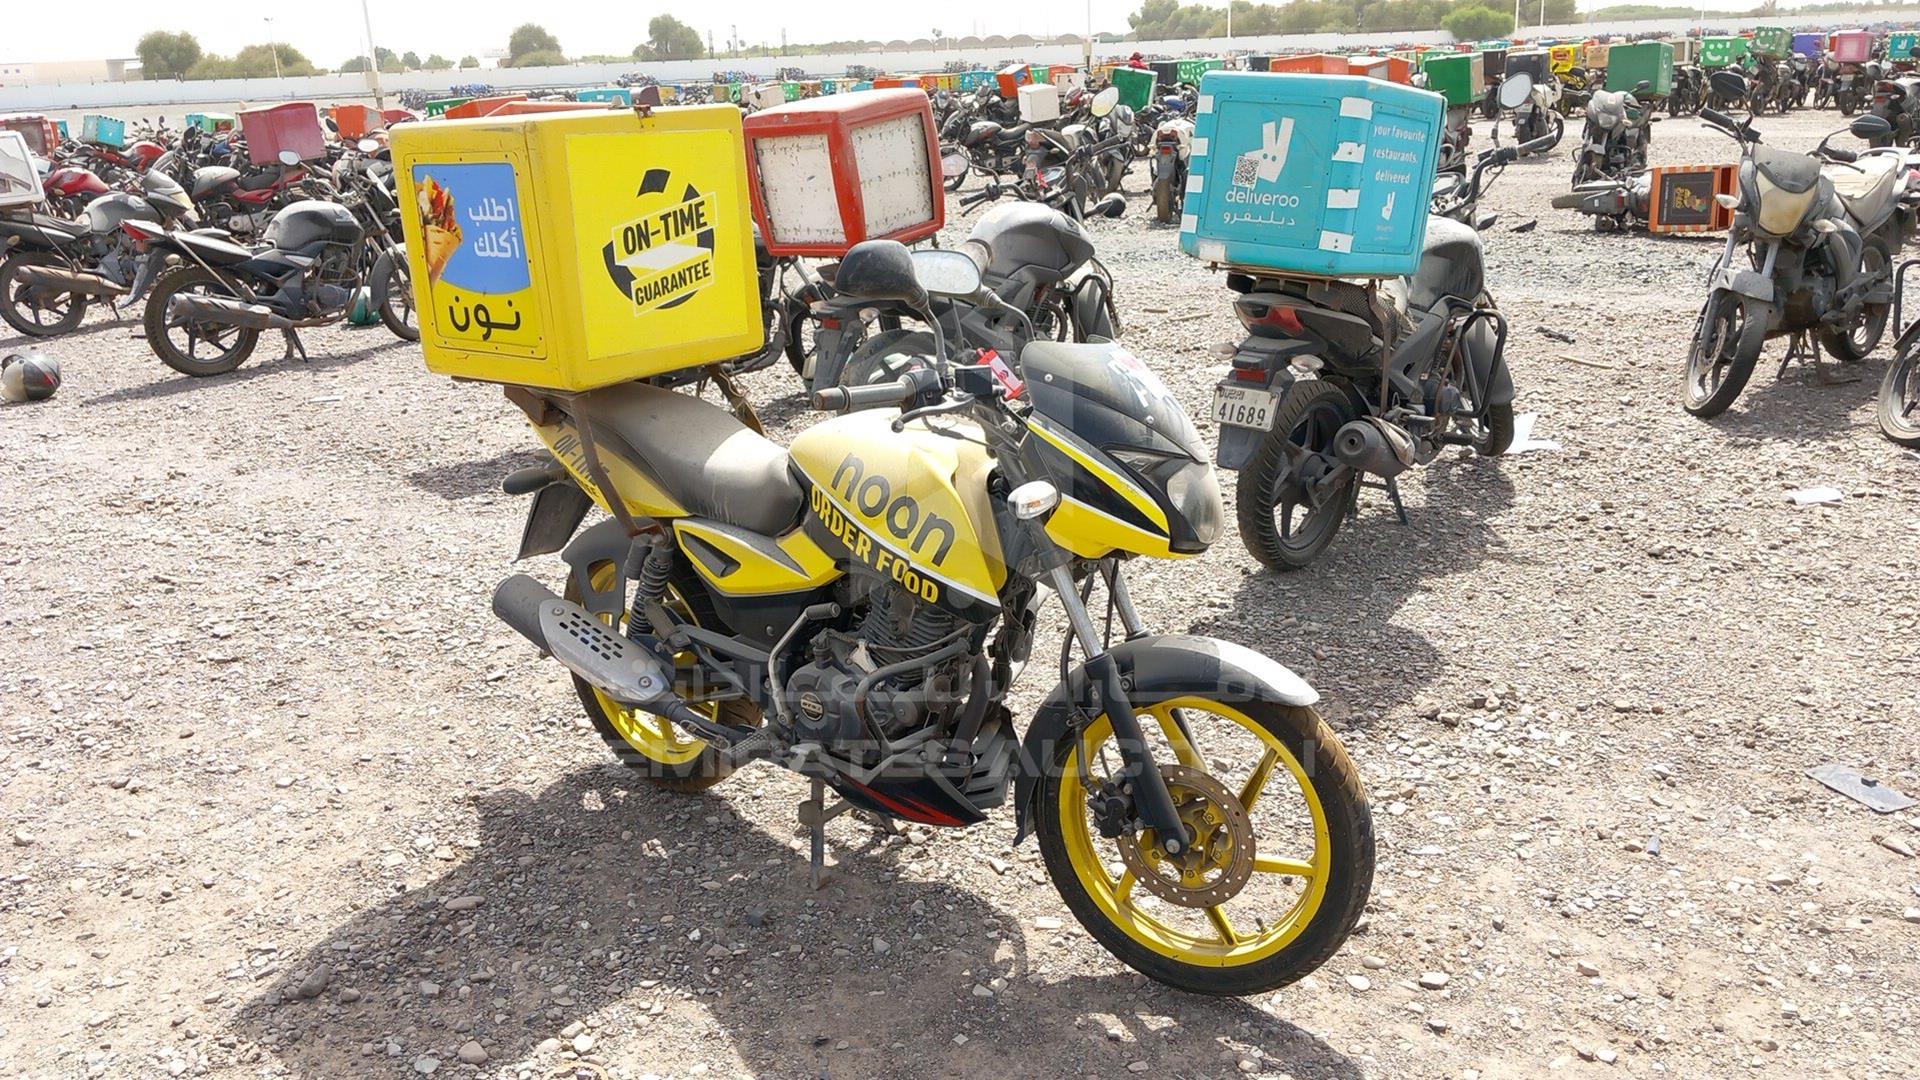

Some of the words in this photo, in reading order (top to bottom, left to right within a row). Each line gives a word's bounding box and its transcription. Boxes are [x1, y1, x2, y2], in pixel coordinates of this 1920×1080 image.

[1373, 125, 1392, 136] your
[1392, 125, 1426, 142] favourite
[1375, 169, 1411, 184] delivered
[468, 197, 515, 228] اطلب
[1225, 187, 1299, 208] deliveroo
[473, 226, 520, 259] أكلك
[622, 200, 708, 255] ON-TIME
[635, 259, 711, 306] GUARANTEE
[448, 295, 521, 341] نون
[1218, 402, 1266, 426] 41689
[831, 452, 955, 567] noon
[811, 484, 872, 564] ORDER
[875, 548, 940, 604] FOOD
